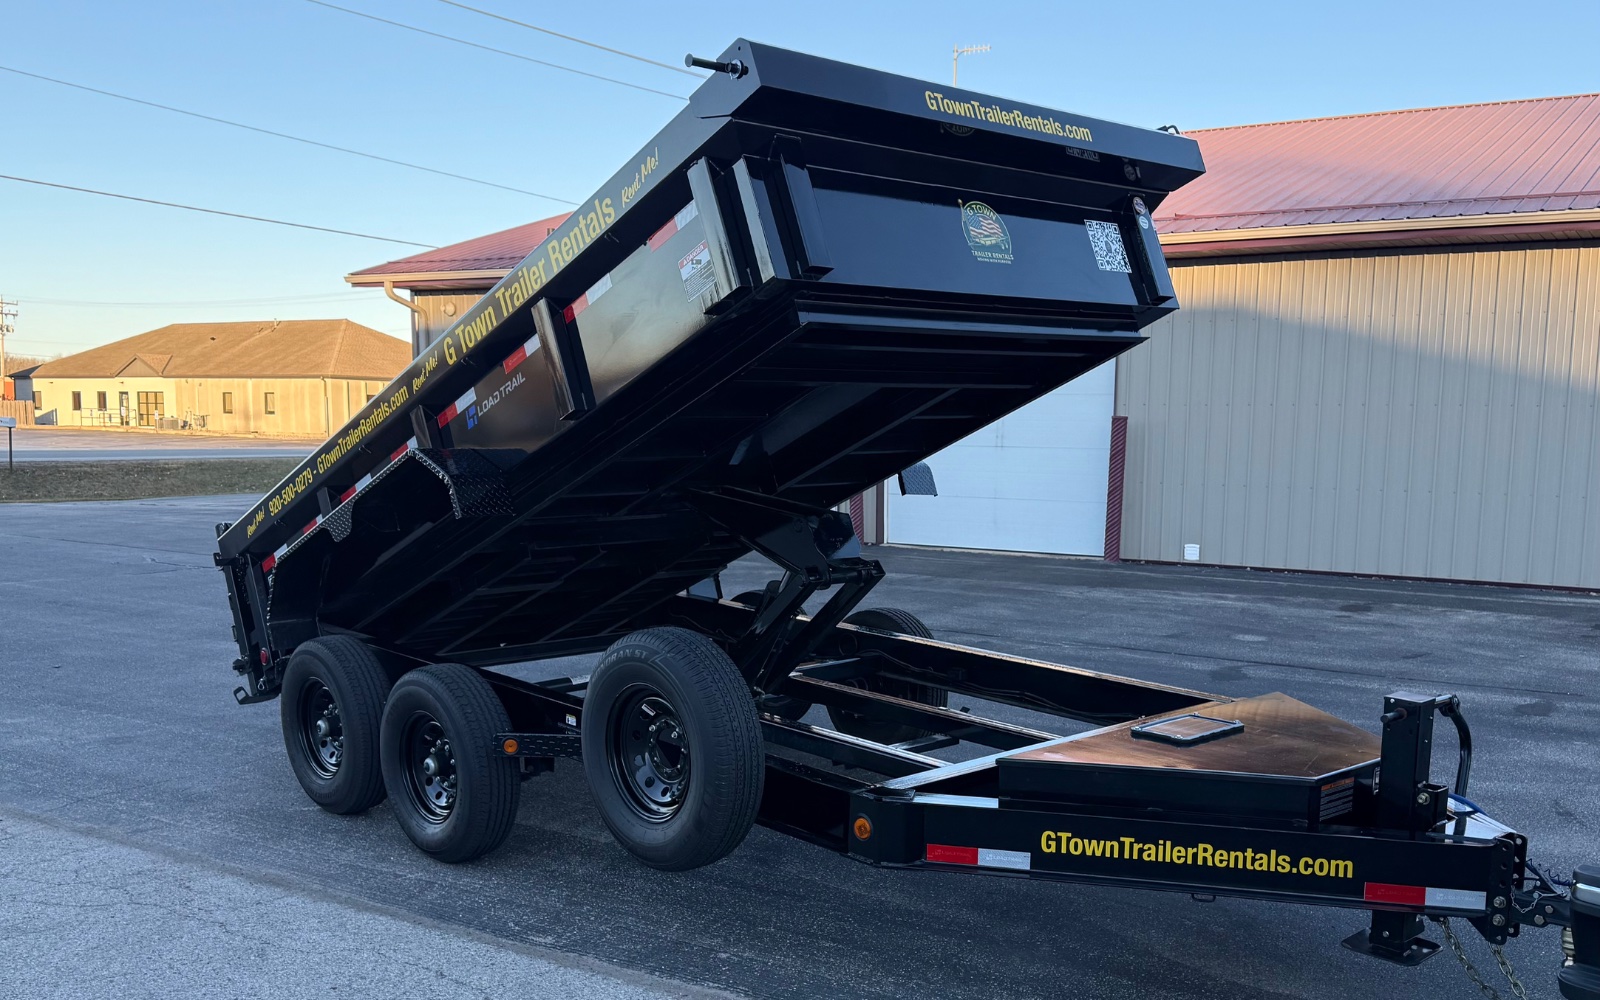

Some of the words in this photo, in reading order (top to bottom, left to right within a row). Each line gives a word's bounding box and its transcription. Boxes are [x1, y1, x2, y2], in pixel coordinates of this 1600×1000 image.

[925, 90, 1093, 142] GTownTrailerRentals.com
[621, 172, 641, 208] Rent
[641, 146, 659, 183] Me!
[971, 204, 998, 221] TOWN
[443, 336, 458, 366] G
[455, 305, 498, 353] Town
[495, 258, 548, 319] Trailer
[547, 197, 616, 275] Rentals
[412, 368, 426, 394] Rent
[425, 350, 438, 377] Me!
[477, 391, 501, 417] LOAD
[499, 371, 526, 398] TRAIL
[268, 467, 313, 516] 920-500-0279
[316, 385, 409, 475] GTownTrailerRentals.com
[1040, 830, 1354, 880] GTownTrailerRentals.com
